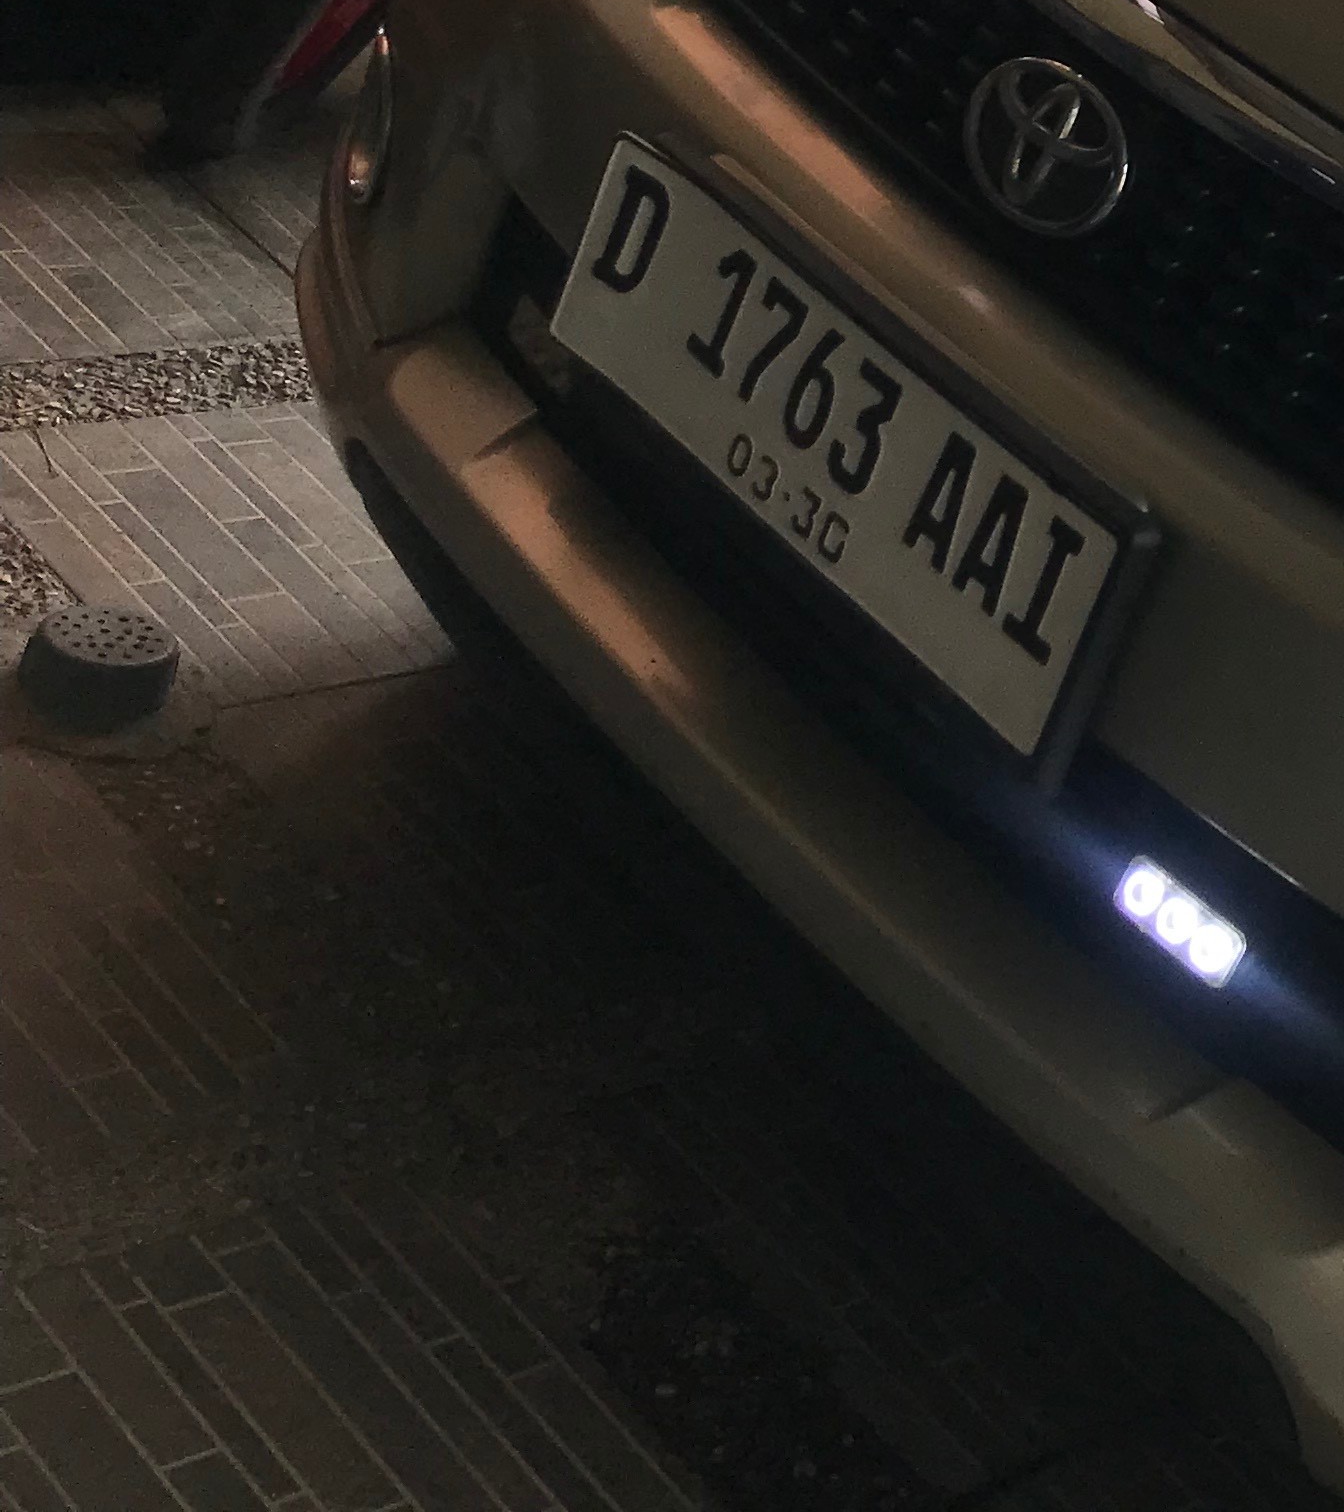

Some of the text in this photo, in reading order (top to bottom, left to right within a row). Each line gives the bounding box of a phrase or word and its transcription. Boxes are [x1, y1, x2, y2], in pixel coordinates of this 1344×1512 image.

[592, 165, 1085, 665] D 1763 AAI
